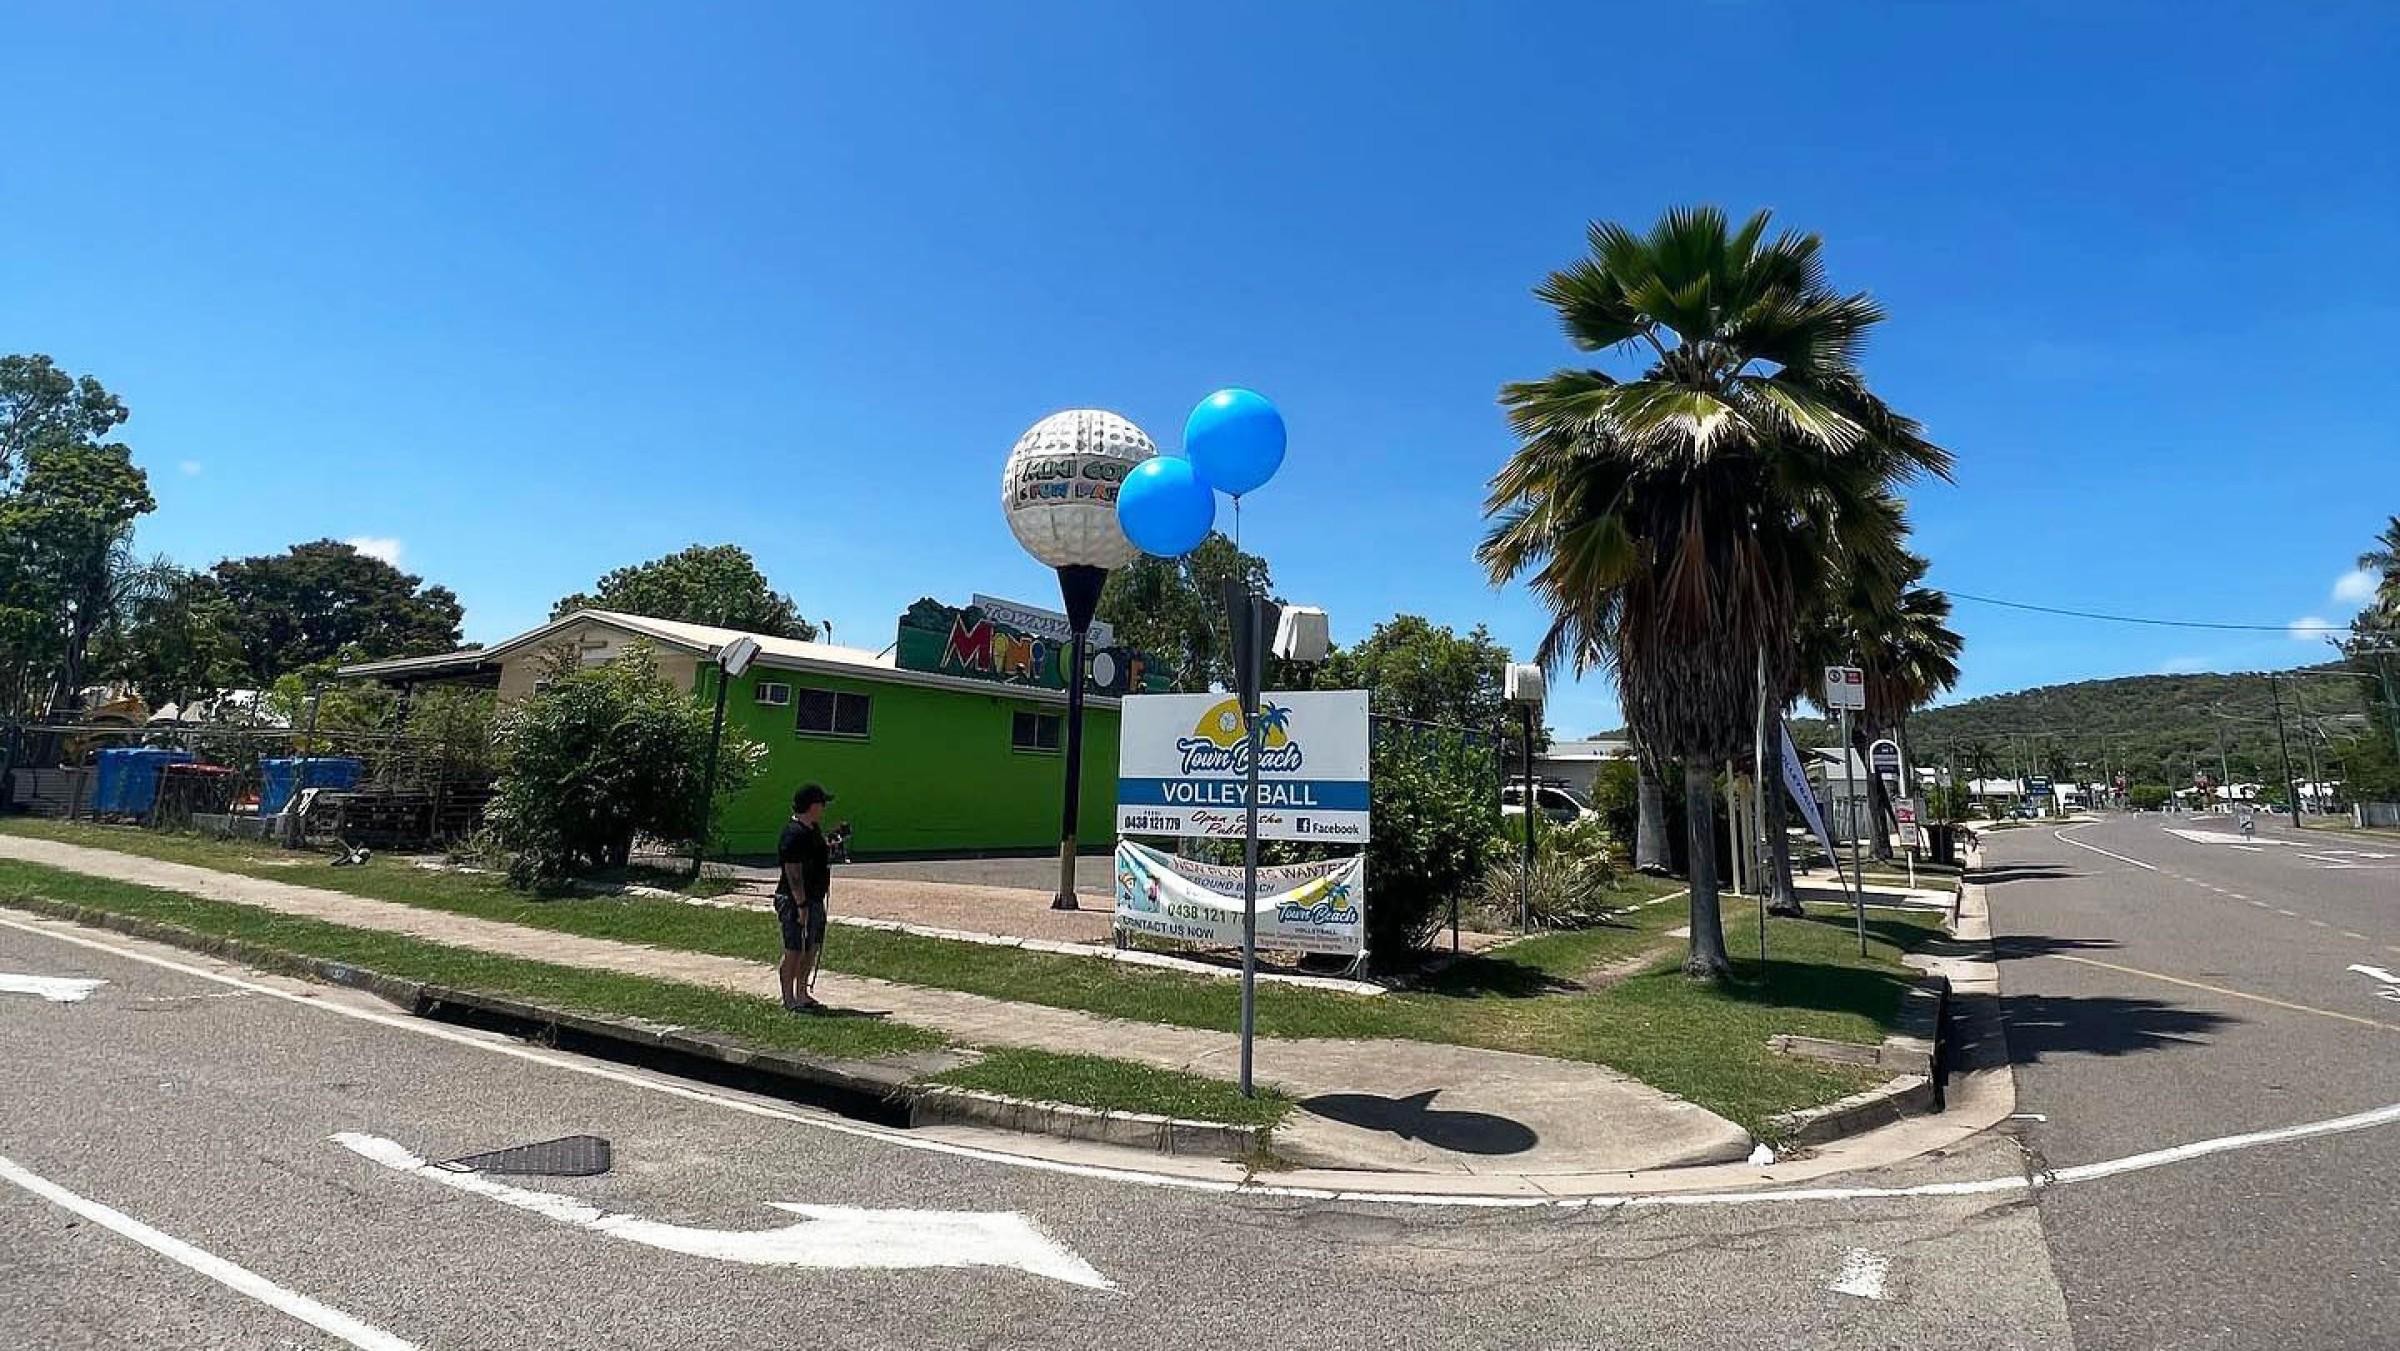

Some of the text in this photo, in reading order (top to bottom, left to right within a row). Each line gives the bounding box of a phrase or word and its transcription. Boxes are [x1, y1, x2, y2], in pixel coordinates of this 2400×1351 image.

[1021, 460, 1078, 481] MINI
[1177, 737, 1302, 775] Town Bach
[1124, 816, 1181, 831] 0438 121 779
[1191, 810, 1227, 824] Open
[1258, 812, 1283, 823] the
[1312, 822, 1359, 835] Facebook
[1168, 904, 1198, 919] 0438
[1203, 908, 1226, 923] 121
[1276, 901, 1359, 925] Town Beach
[1170, 924, 1185, 936] US
[1187, 926, 1215, 939] NOW
